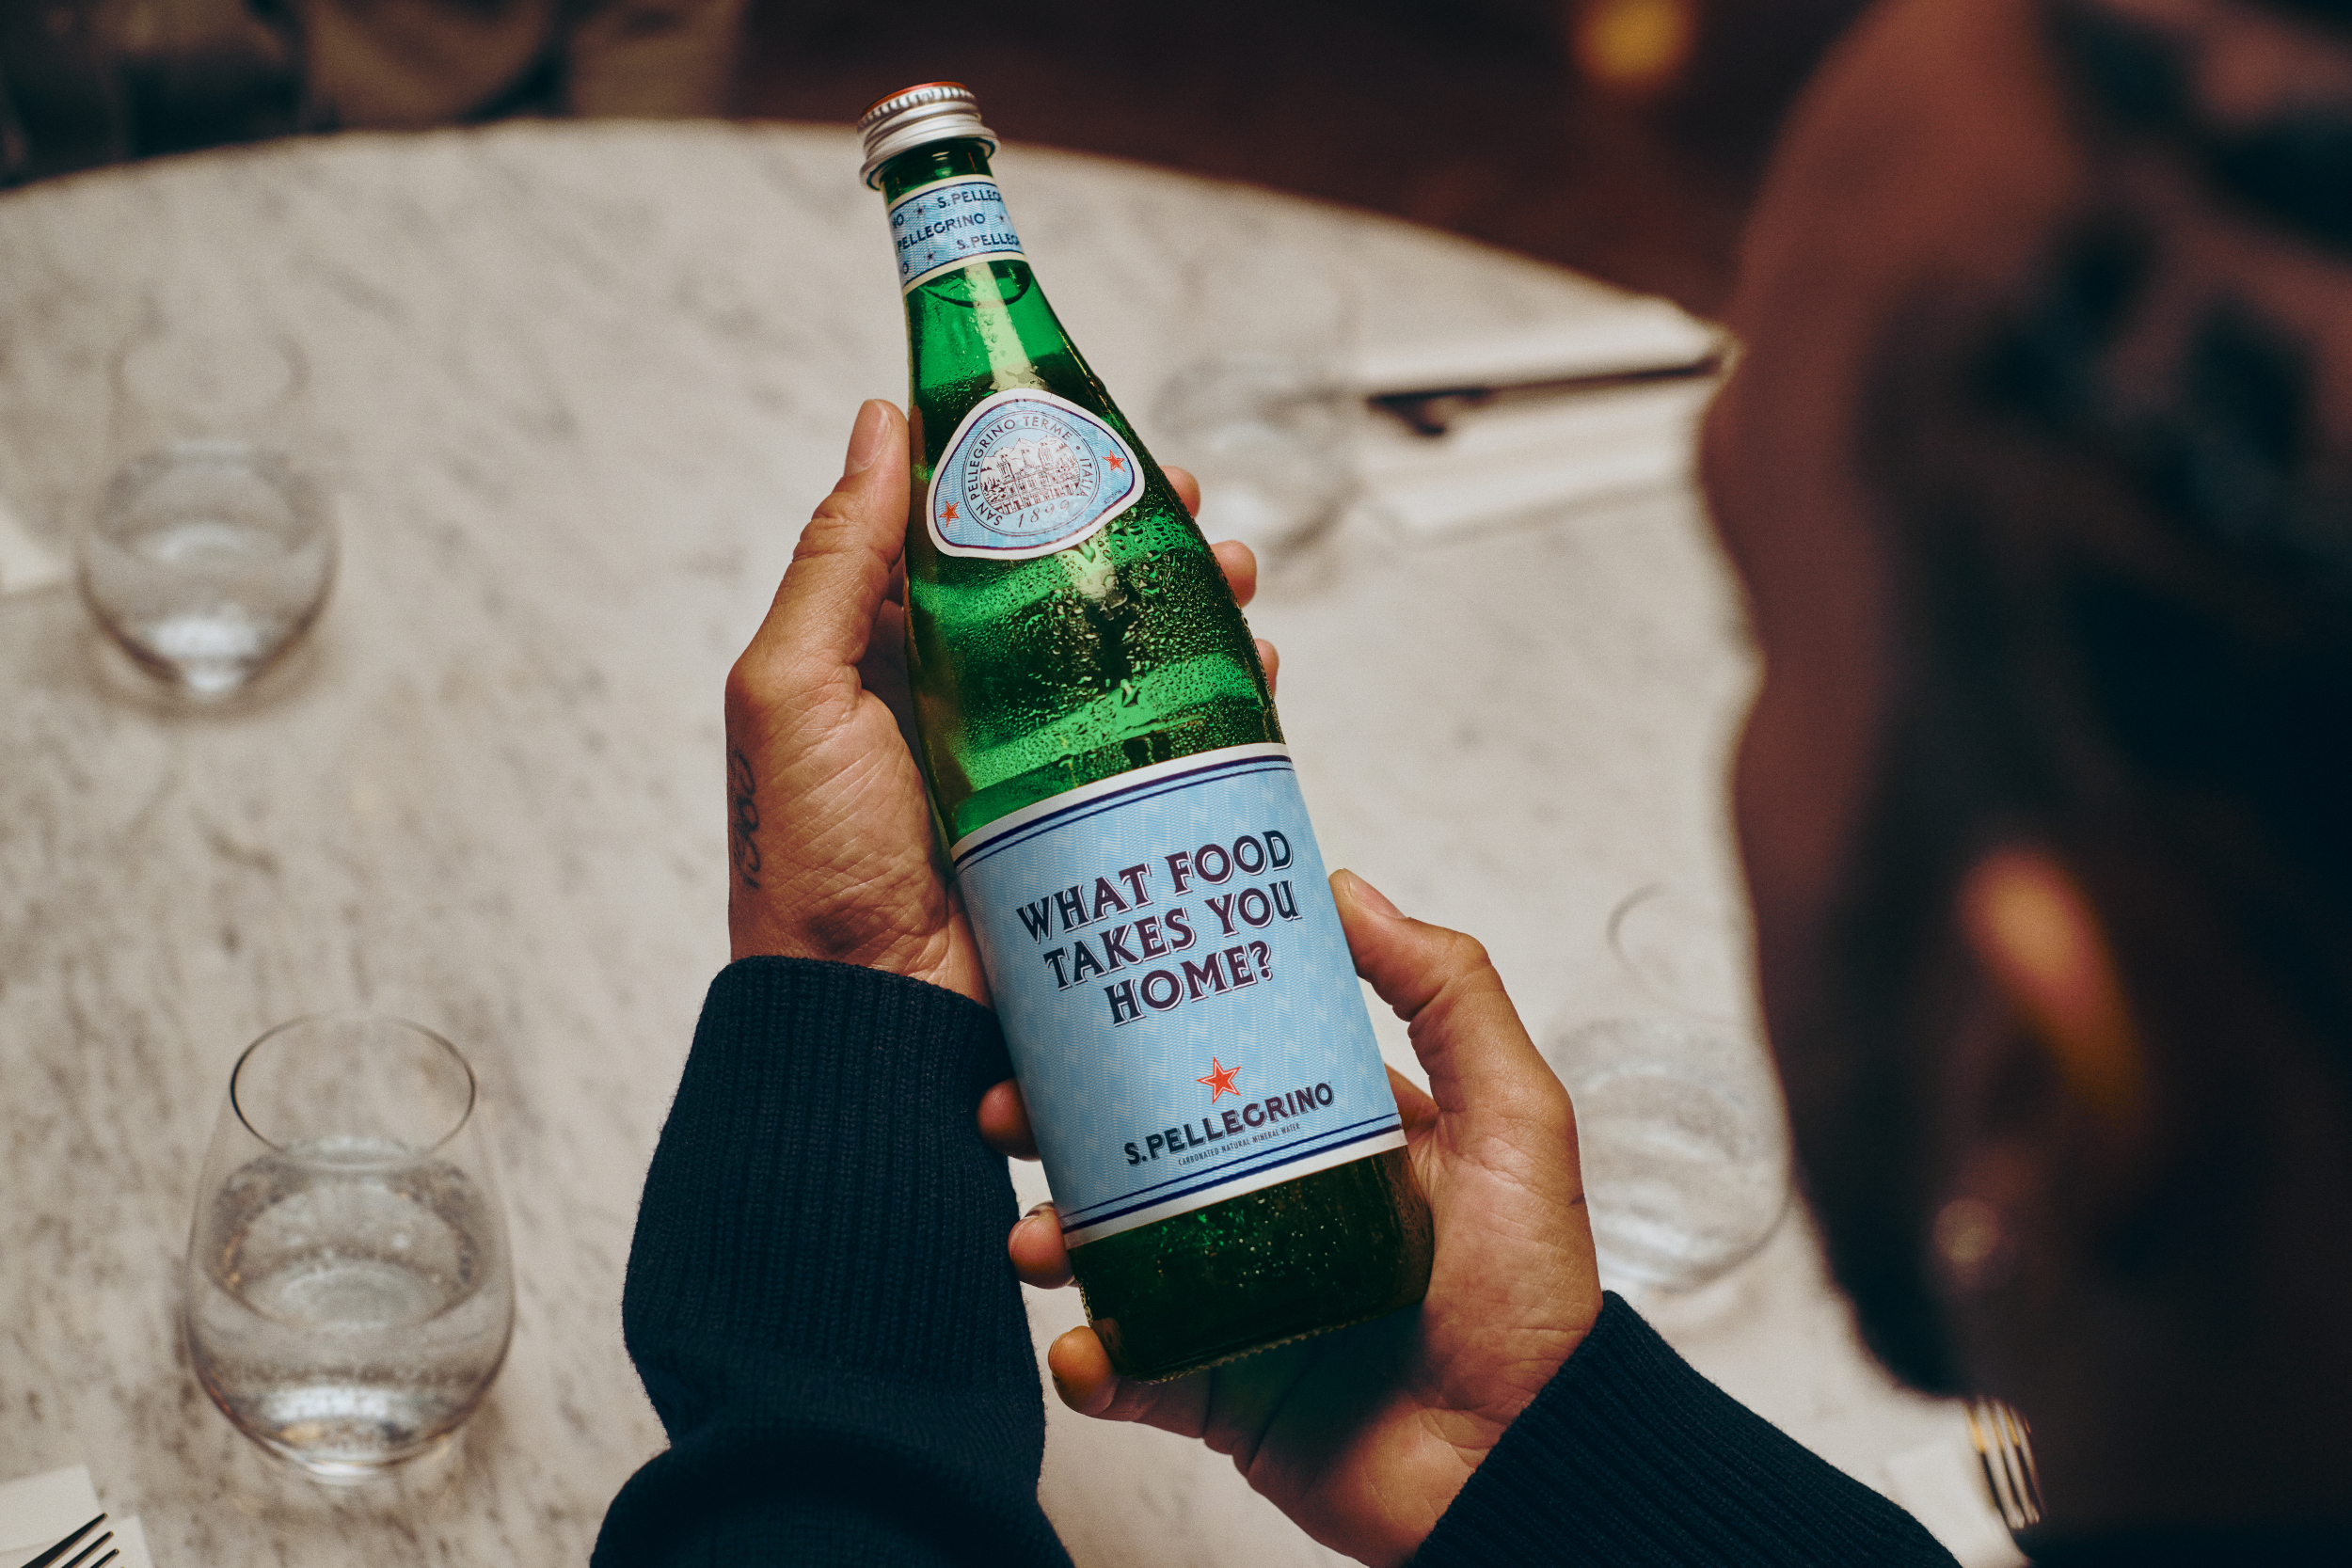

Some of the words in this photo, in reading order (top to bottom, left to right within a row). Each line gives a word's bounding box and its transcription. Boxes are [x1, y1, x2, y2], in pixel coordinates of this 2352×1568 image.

[1023, 416, 1073, 440] TERME
[968, 420, 1015, 500] PELLEGRINO
[1076, 458, 1094, 497] ITALIA
[977, 502, 1003, 526] SAN
[1018, 499, 1070, 528] 1899
[1016, 863, 1153, 944] WHAT
[1165, 830, 1294, 896] FOOD
[1042, 907, 1196, 991] TAKES
[1204, 879, 1302, 938] YOU
[1103, 940, 1273, 1027] HOME?
[1123, 1082, 1334, 1165] S.PELLEGRINO
[1178, 1148, 1219, 1166] CARBONATED
[1221, 1138, 1250, 1153] NATURAL
[1252, 1129, 1279, 1144] MINERAL
[1279, 1122, 1301, 1134] WATER
